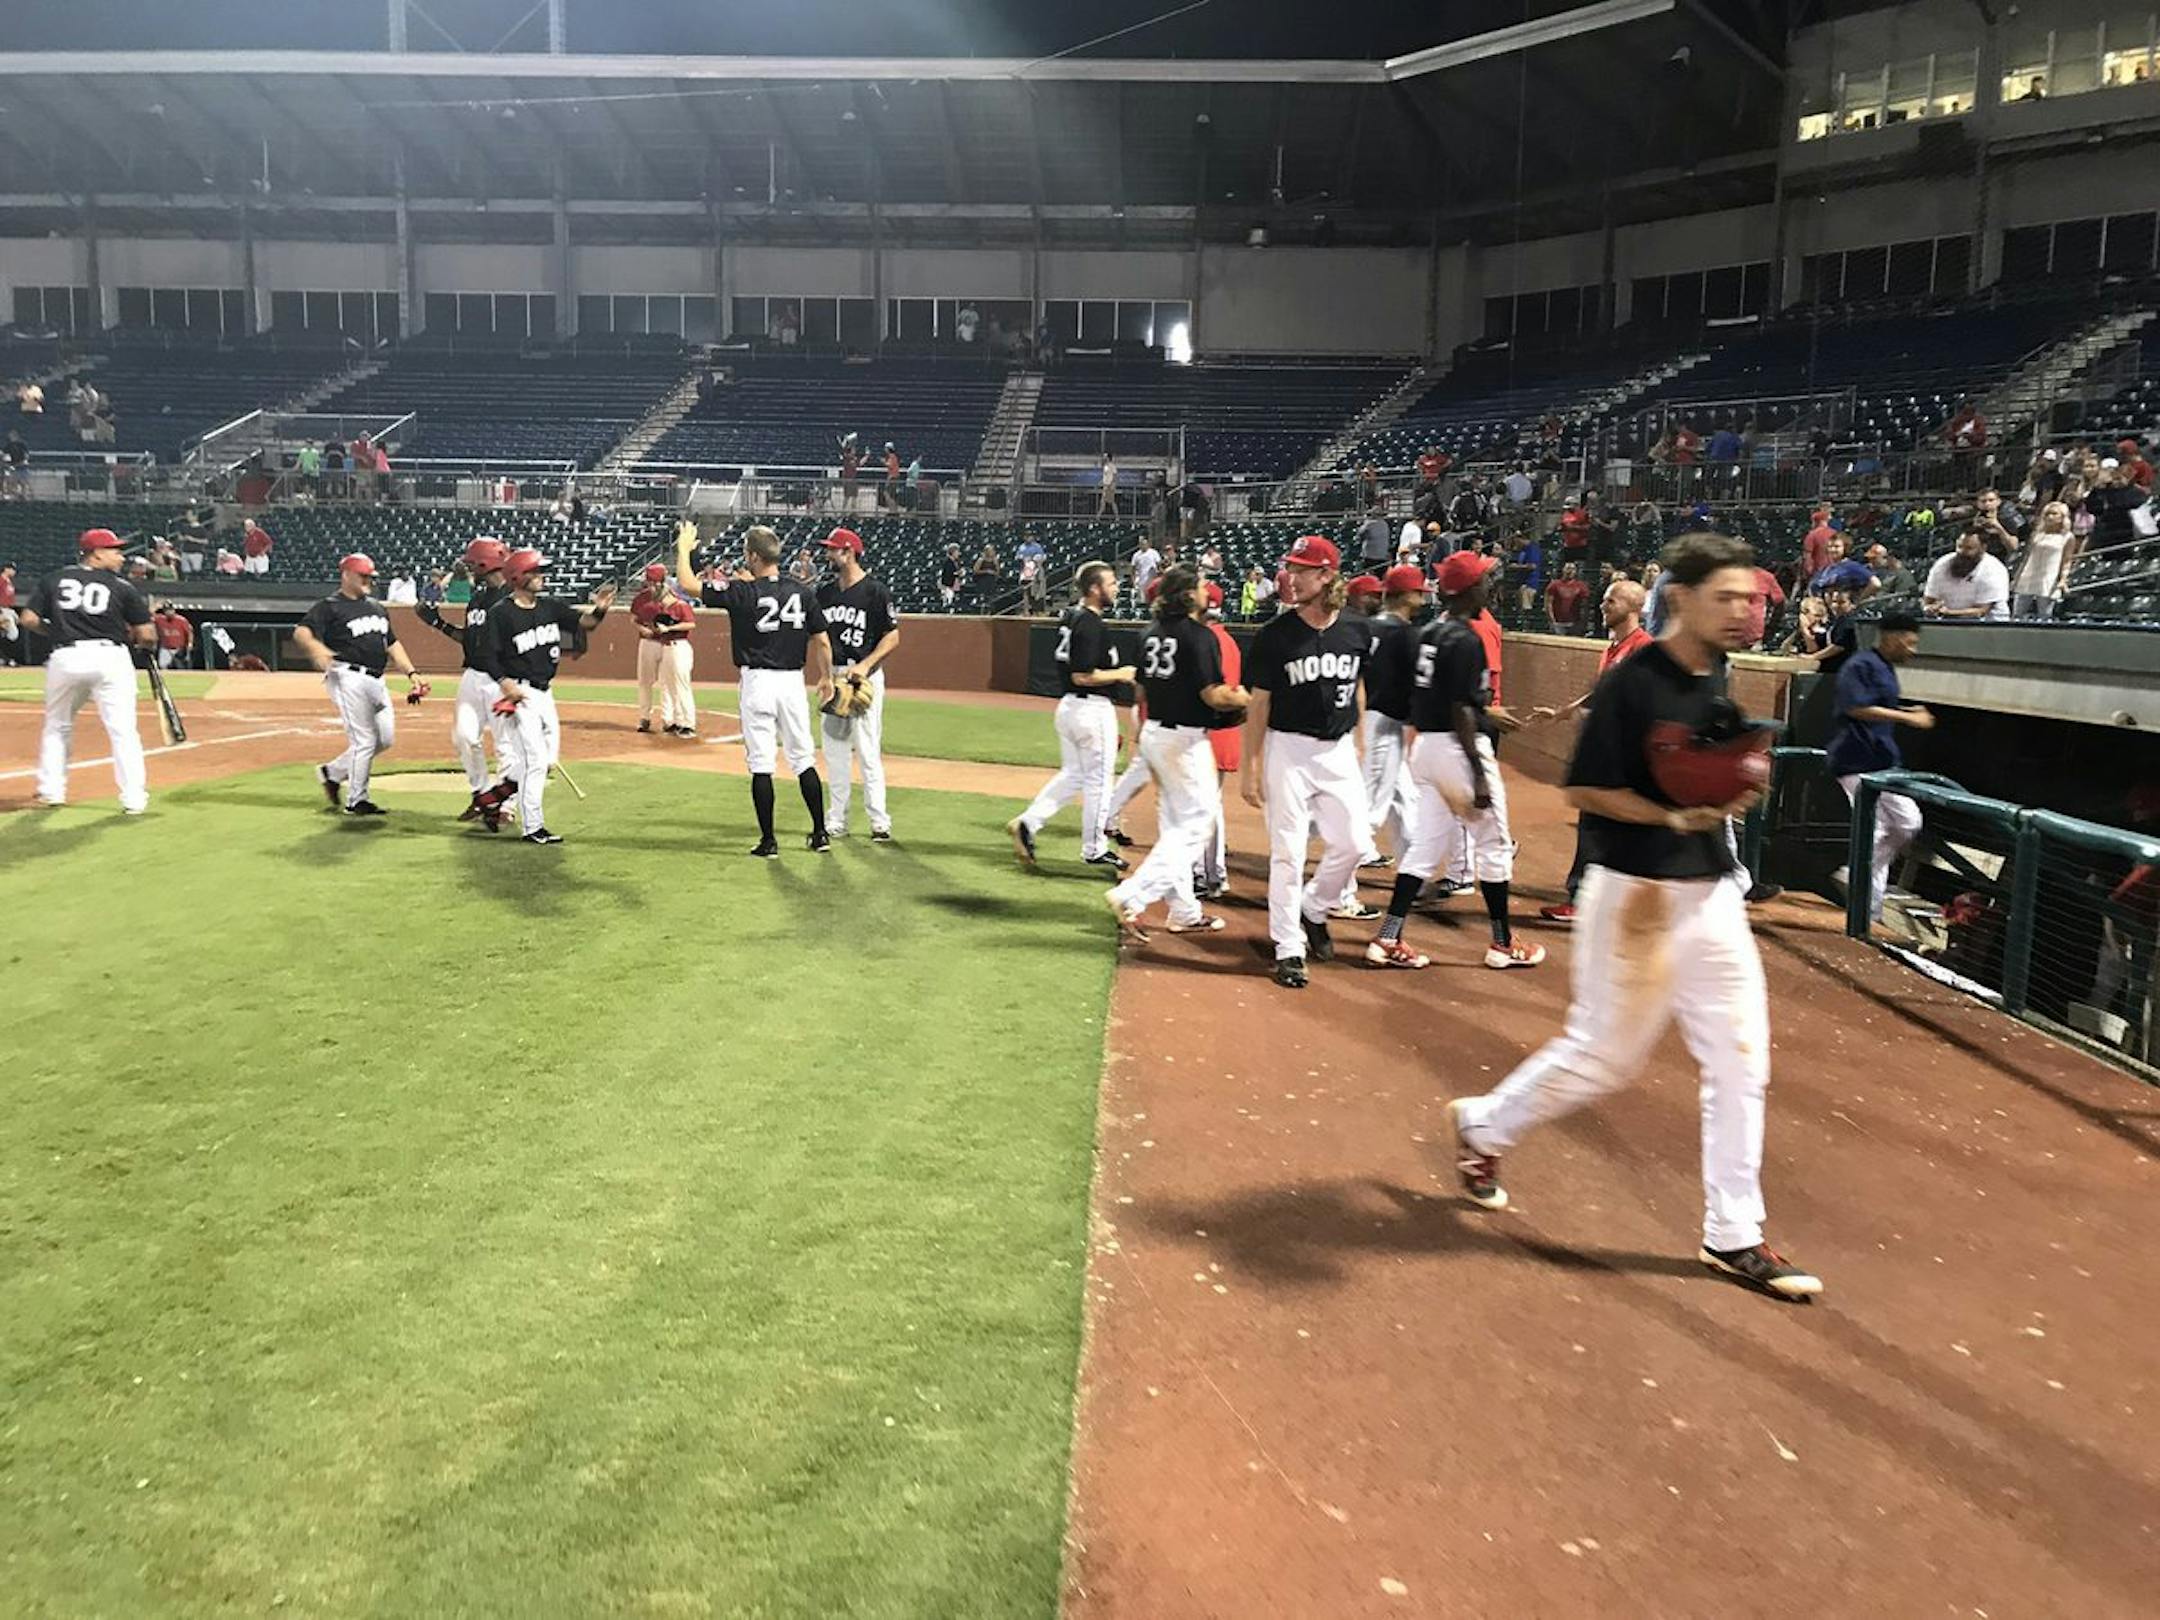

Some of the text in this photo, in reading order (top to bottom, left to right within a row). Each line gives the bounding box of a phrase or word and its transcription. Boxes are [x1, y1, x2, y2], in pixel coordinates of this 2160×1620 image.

[58, 578, 111, 615] 30
[756, 593, 806, 633] 24
[840, 627, 866, 648] 45
[1143, 636, 1179, 679] 33
